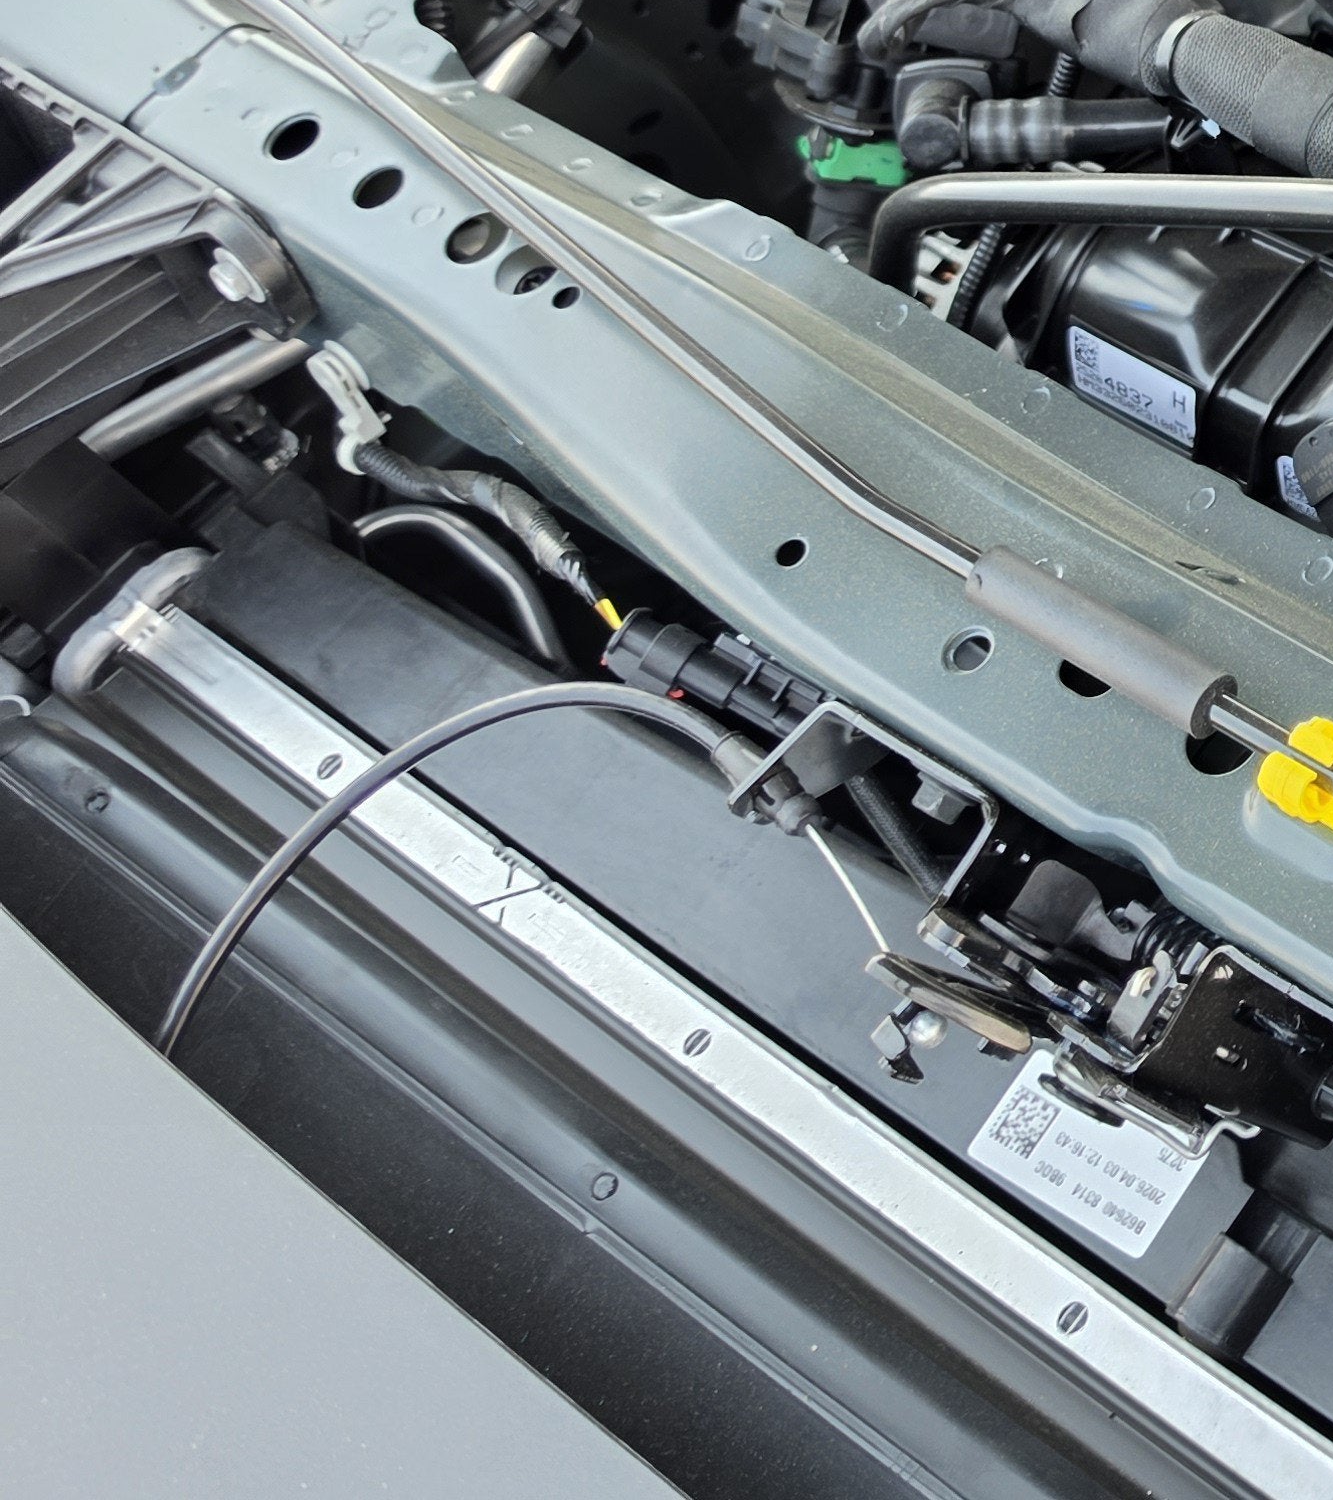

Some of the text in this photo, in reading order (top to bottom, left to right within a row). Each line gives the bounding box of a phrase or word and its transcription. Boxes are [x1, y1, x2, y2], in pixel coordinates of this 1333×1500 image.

[1104, 377, 1154, 408] 4837
[1172, 390, 1187, 415] H
[1054, 1131, 1167, 1206] 2026.04.03 12:16:43
[1072, 1182, 1101, 1209] 8314
